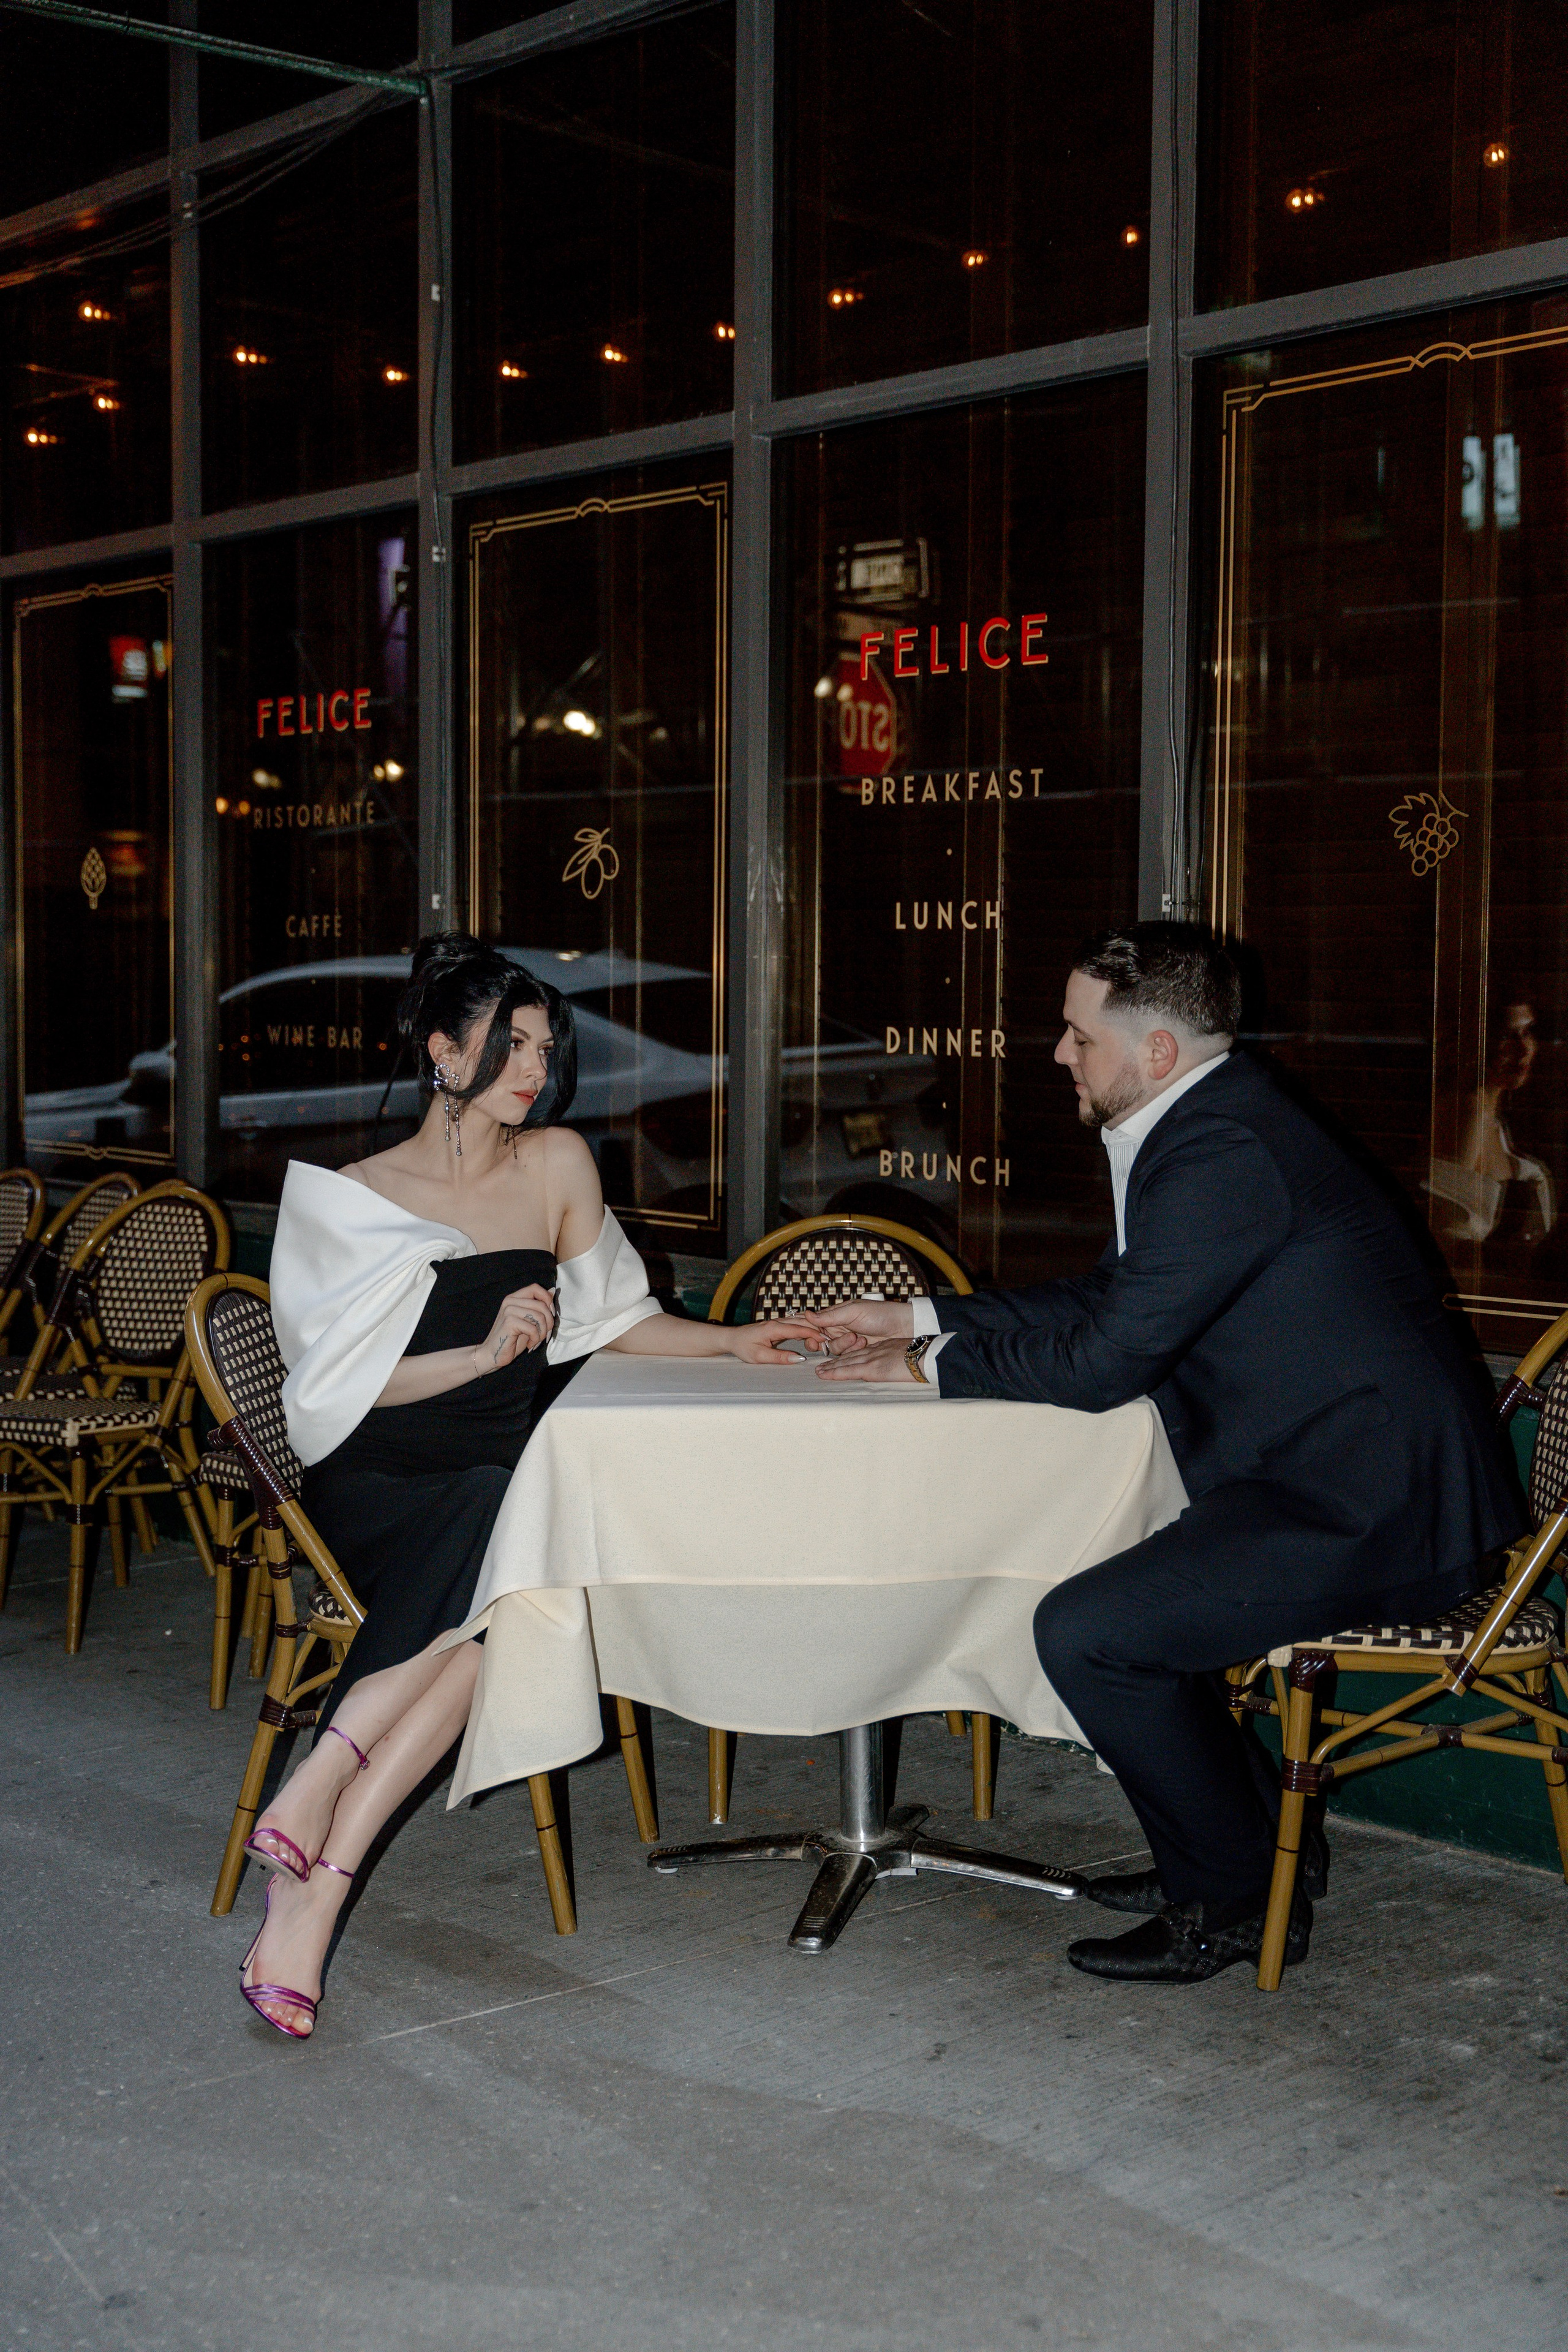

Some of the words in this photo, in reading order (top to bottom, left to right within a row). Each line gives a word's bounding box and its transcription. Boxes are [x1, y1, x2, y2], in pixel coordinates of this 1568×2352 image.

[861, 613, 1049, 680] FELICE
[257, 688, 372, 738] FELICE
[861, 769, 1044, 805] BREAKFAST
[254, 801, 374, 829] RISTORANTE
[895, 901, 1001, 929] LUNCH
[268, 1025, 315, 1047] WINE
[328, 1027, 363, 1050] BAR
[886, 1027, 1006, 1058] DINNER
[880, 1150, 1009, 1186] BRUNCH
